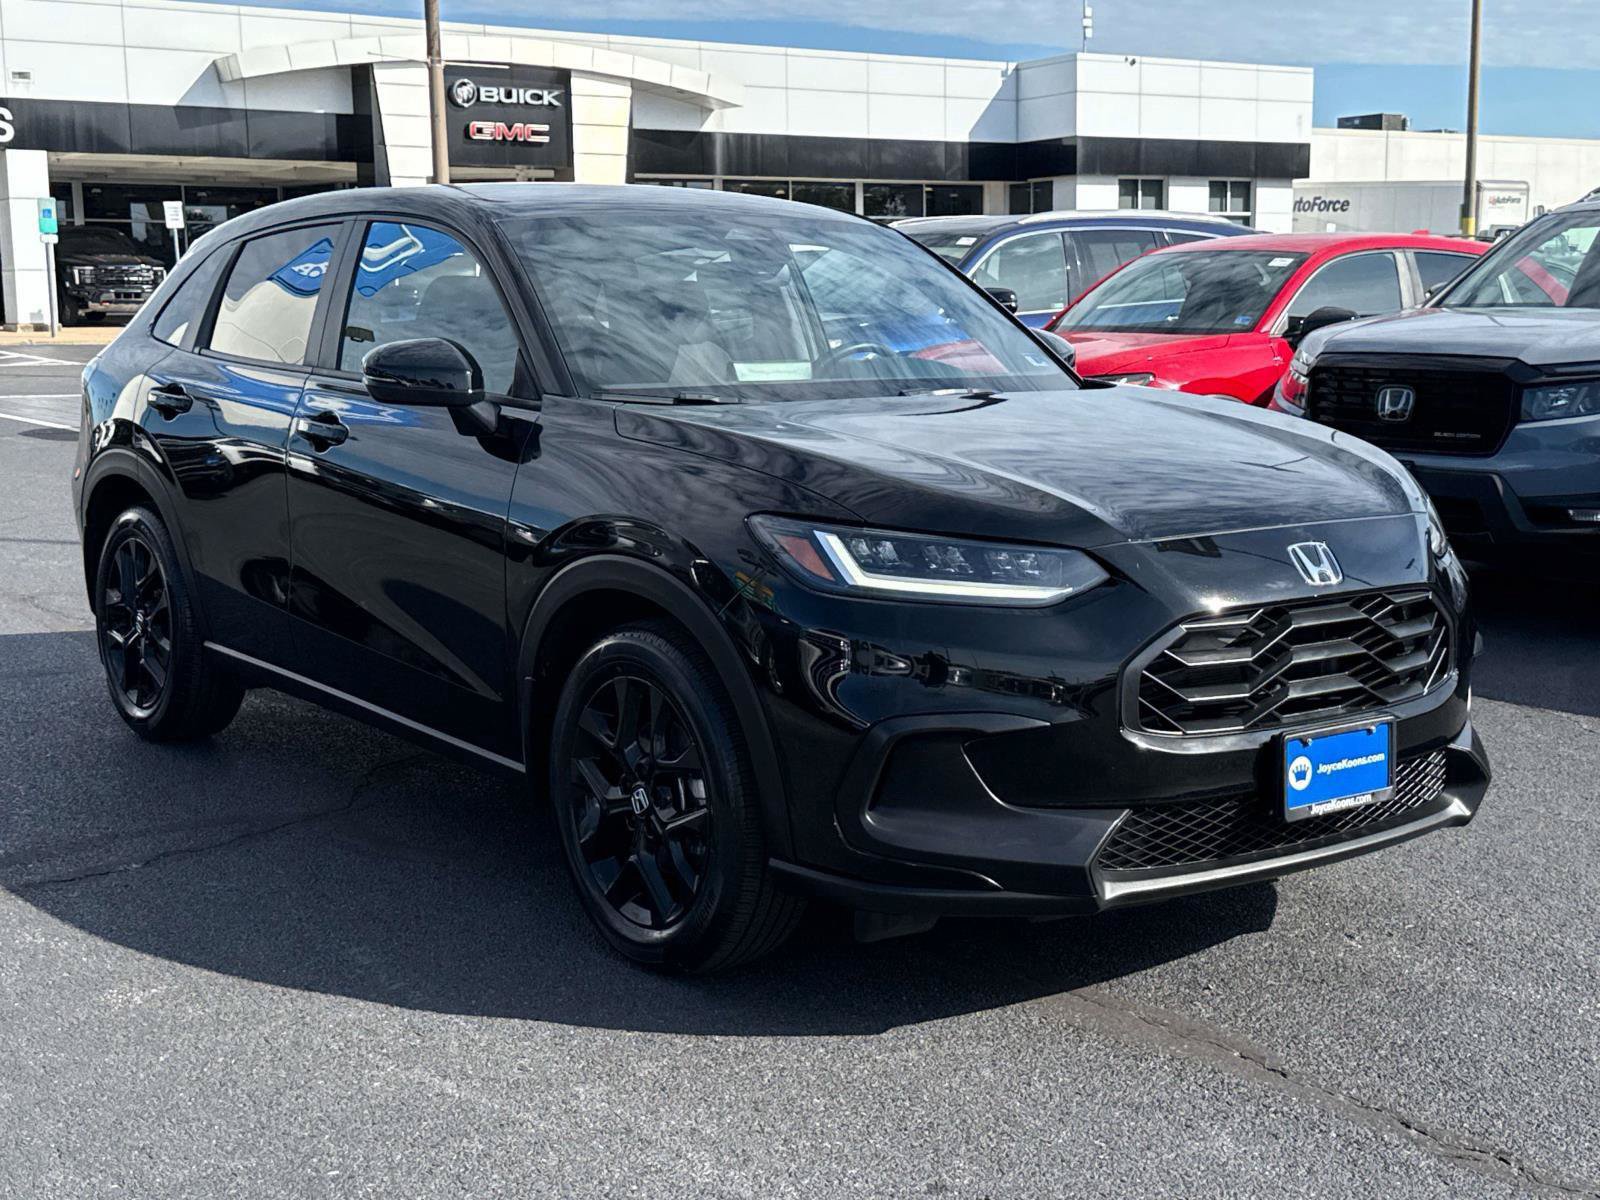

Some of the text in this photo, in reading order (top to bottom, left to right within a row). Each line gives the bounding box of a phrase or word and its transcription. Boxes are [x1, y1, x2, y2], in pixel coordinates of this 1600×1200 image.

[480, 86, 564, 107] BUICK
[469, 120, 550, 143] GMC
[1316, 752, 1385, 775] JoyceKoons.com
[1310, 793, 1372, 815] JoyceKoons.com
